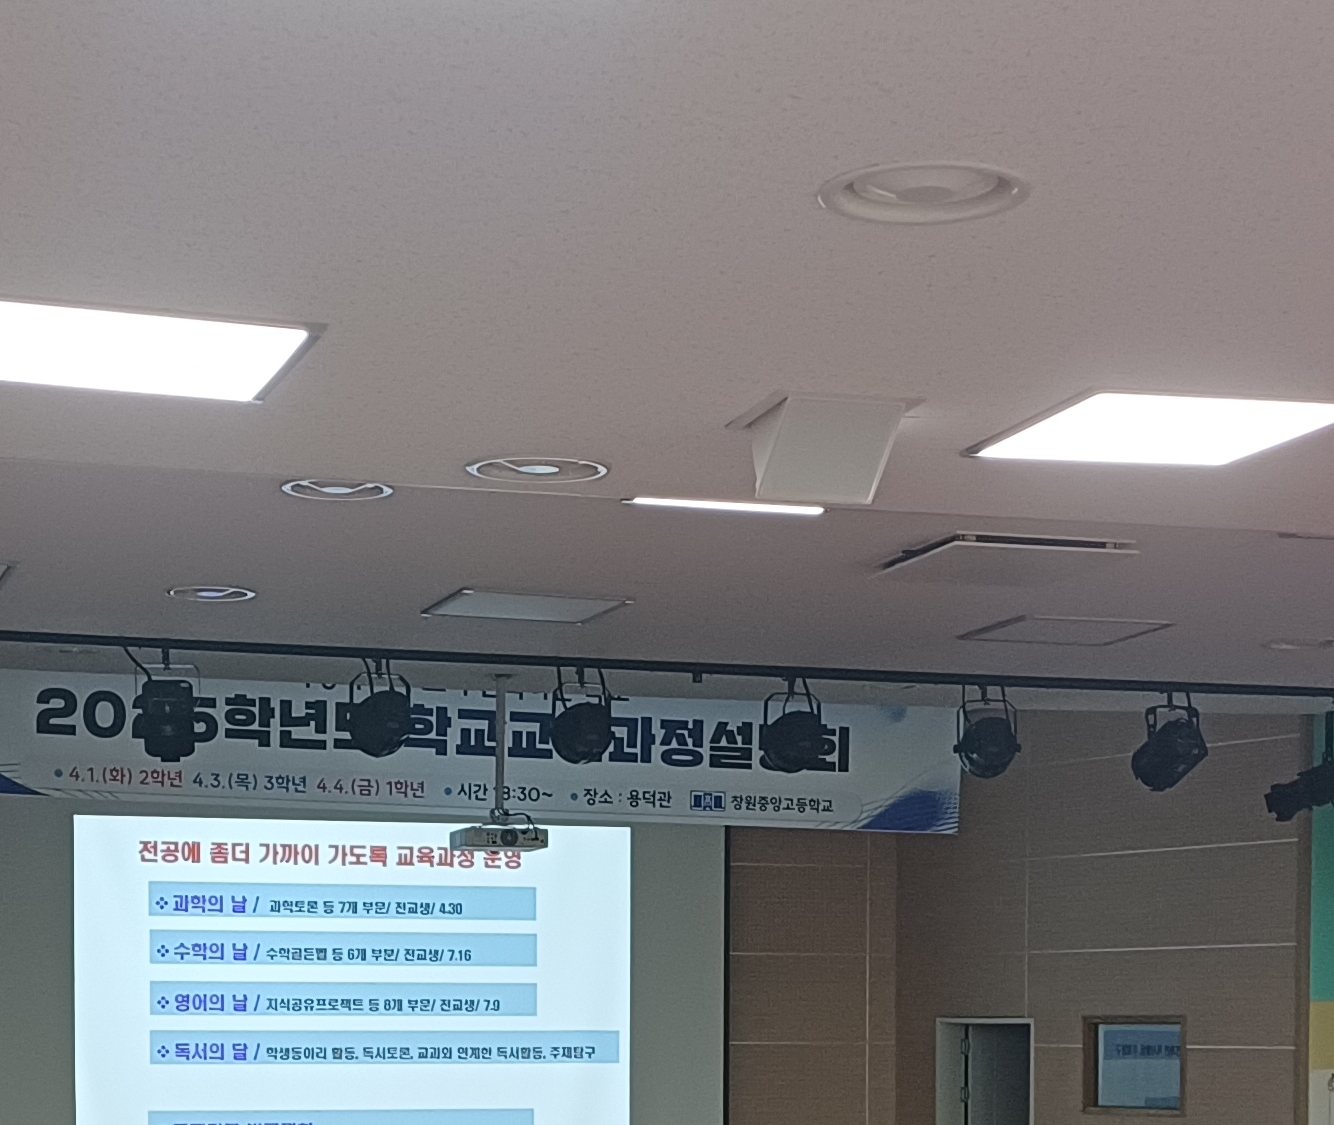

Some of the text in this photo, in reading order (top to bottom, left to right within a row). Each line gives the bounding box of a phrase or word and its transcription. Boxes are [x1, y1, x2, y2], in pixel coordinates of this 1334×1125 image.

[401, 703, 850, 773] 학교교과정설회
[69, 766, 132, 785] 4.1.(화)
[139, 768, 183, 788] 2학년
[192, 772, 258, 791] 4.3.(목)
[264, 774, 307, 794] 3학년
[317, 777, 379, 797] 4.4.(금)
[386, 779, 425, 799] 1학년
[457, 782, 488, 801] 시간
[493, 785, 553, 802] 8:30~
[583, 787, 614, 806] 장소
[626, 789, 672, 808] 용덕관
[731, 795, 834, 813] 창원중앙고등학교
[138, 840, 522, 870] 전공에 좀더 가까이 가도록 교육과정 운영
[173, 895, 223, 913] 과학의
[231, 895, 247, 913] 날
[323, 901, 334, 914] 등
[338, 901, 358, 914] 7개
[439, 903, 462, 915] 4.30
[174, 942, 224, 961] 수학의
[232, 943, 248, 961] 날
[332, 948, 343, 961] 등
[348, 948, 366, 961] 6개
[447, 949, 471, 961] 7.16
[175, 994, 224, 1012] 영어의
[232, 994, 248, 1012] 날
[266, 998, 364, 1012] 지식공유프로젝트
[369, 999, 379, 1012] 등
[175, 1043, 224, 1061] 독서의
[232, 1043, 248, 1061] 달
